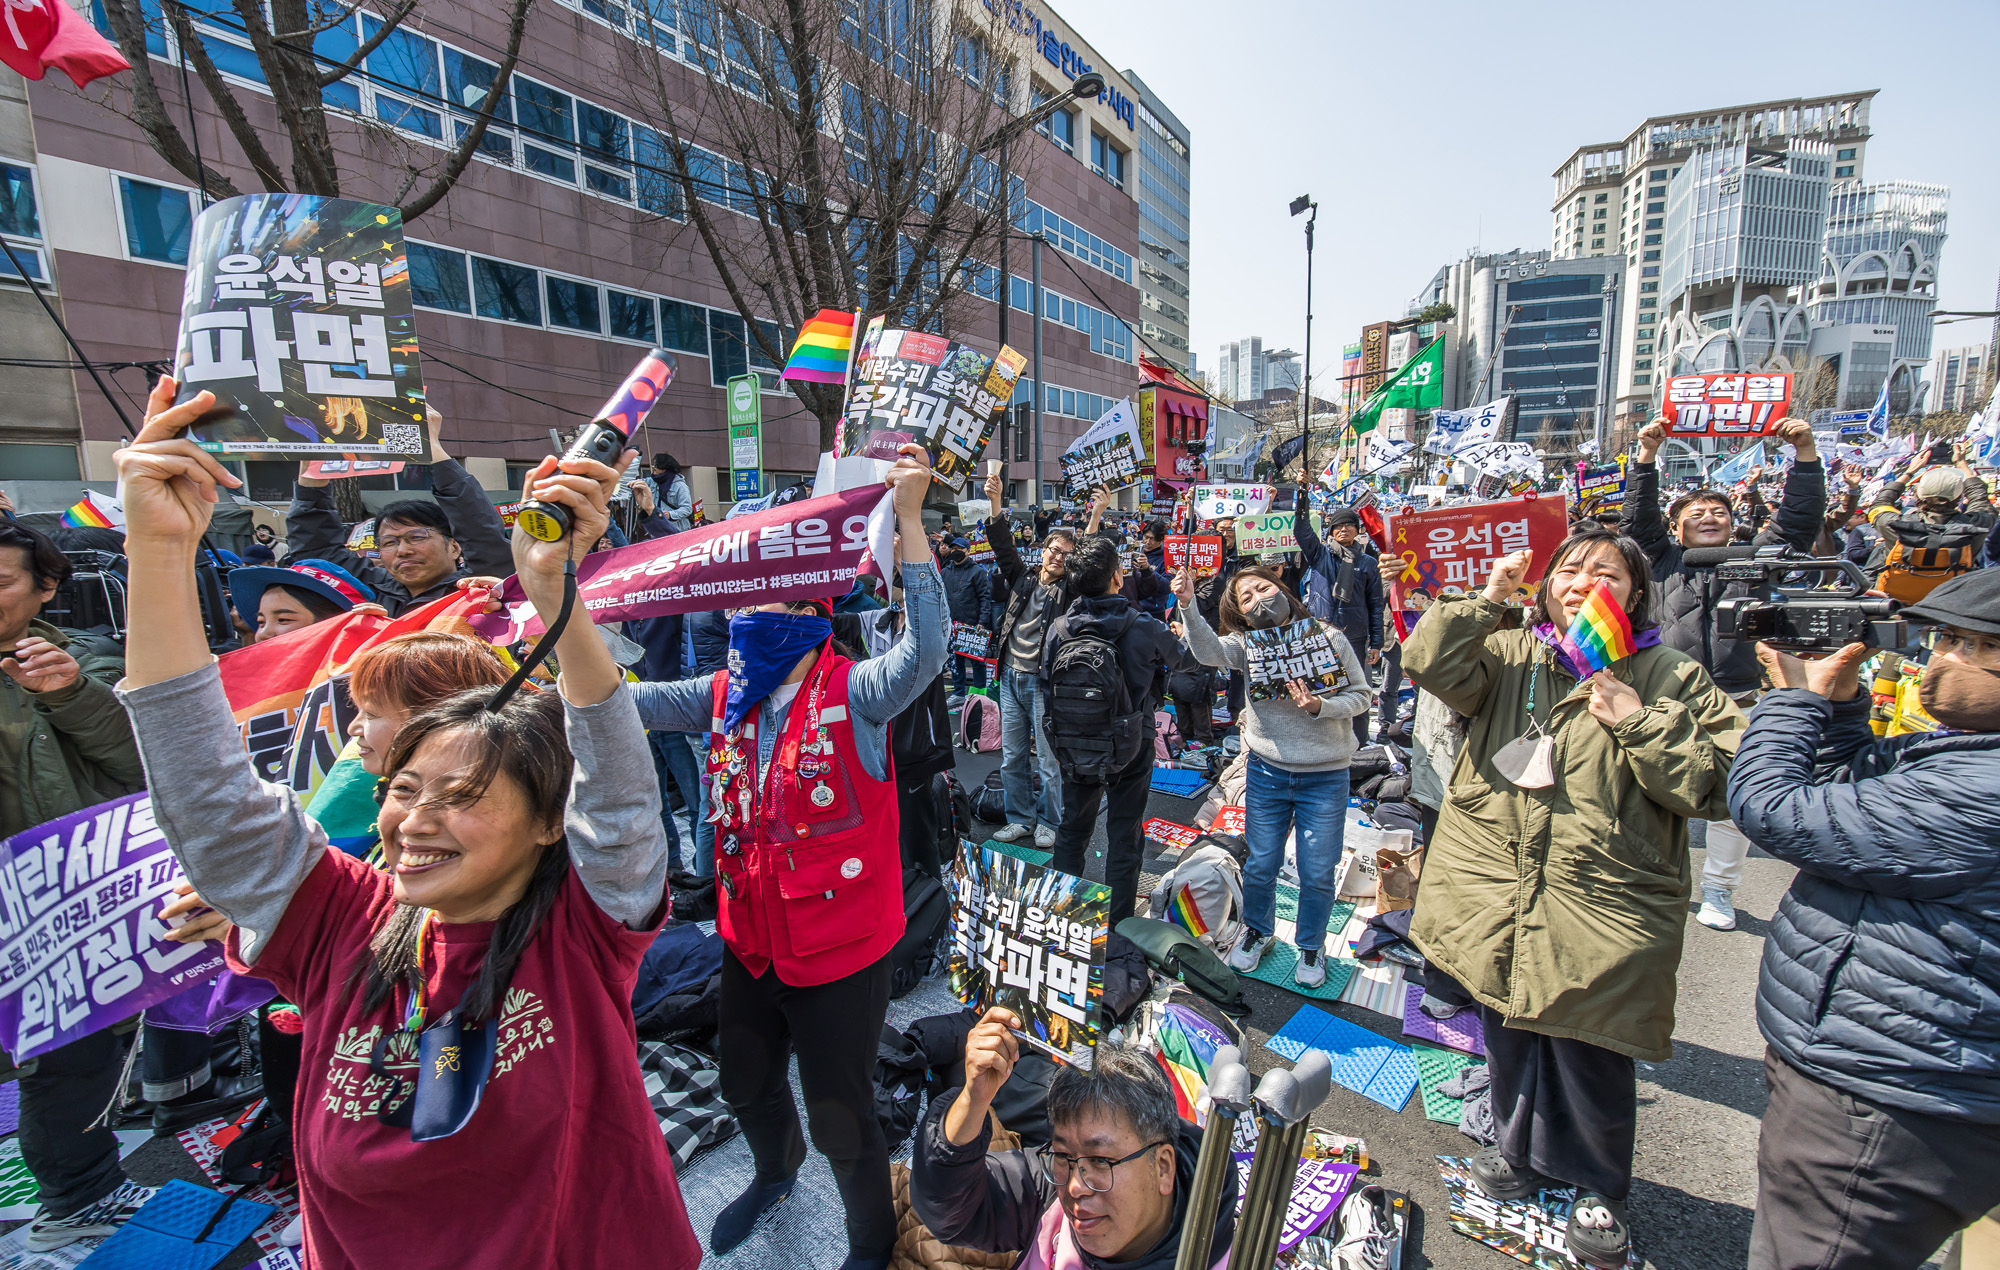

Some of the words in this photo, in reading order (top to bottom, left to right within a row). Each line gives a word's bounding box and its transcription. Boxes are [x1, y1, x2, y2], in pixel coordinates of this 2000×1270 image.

[214, 253, 385, 309] 윤석열
[1518, 263, 1547, 277] 동일
[183, 306, 397, 398] 파면
[859, 359, 930, 388] 내란수괴
[932, 371, 996, 420] 윤석열
[1669, 376, 1788, 403] 윤석열
[849, 385, 986, 462] 즉각파면
[1145, 402, 1155, 455] 서울커피
[1671, 403, 1775, 433] 파면!
[1067, 454, 1102, 475] 내란수괴
[1102, 445, 1131, 464] 윤석열
[1071, 456, 1136, 491] 즉각파면
[1215, 502, 1224, 515] 8
[1236, 503, 1246, 515] 0
[757, 518, 832, 560] 봄은
[1168, 543, 1198, 555] 윤석열
[1199, 543, 1218, 554] 파면
[1242, 536, 1277, 550] 대청소
[1425, 518, 1531, 559] 윤석열
[769, 569, 831, 588] #동덕여대
[1194, 555, 1213, 567] 혁명
[1246, 643, 1290, 662] 내란수괴
[1290, 633, 1330, 655] 윤석열
[1248, 646, 1340, 686] 즉각파면
[959, 878, 1021, 932] 내란수괴
[1023, 906, 1094, 960] 윤석열
[955, 909, 1090, 1026] 즉각파면
